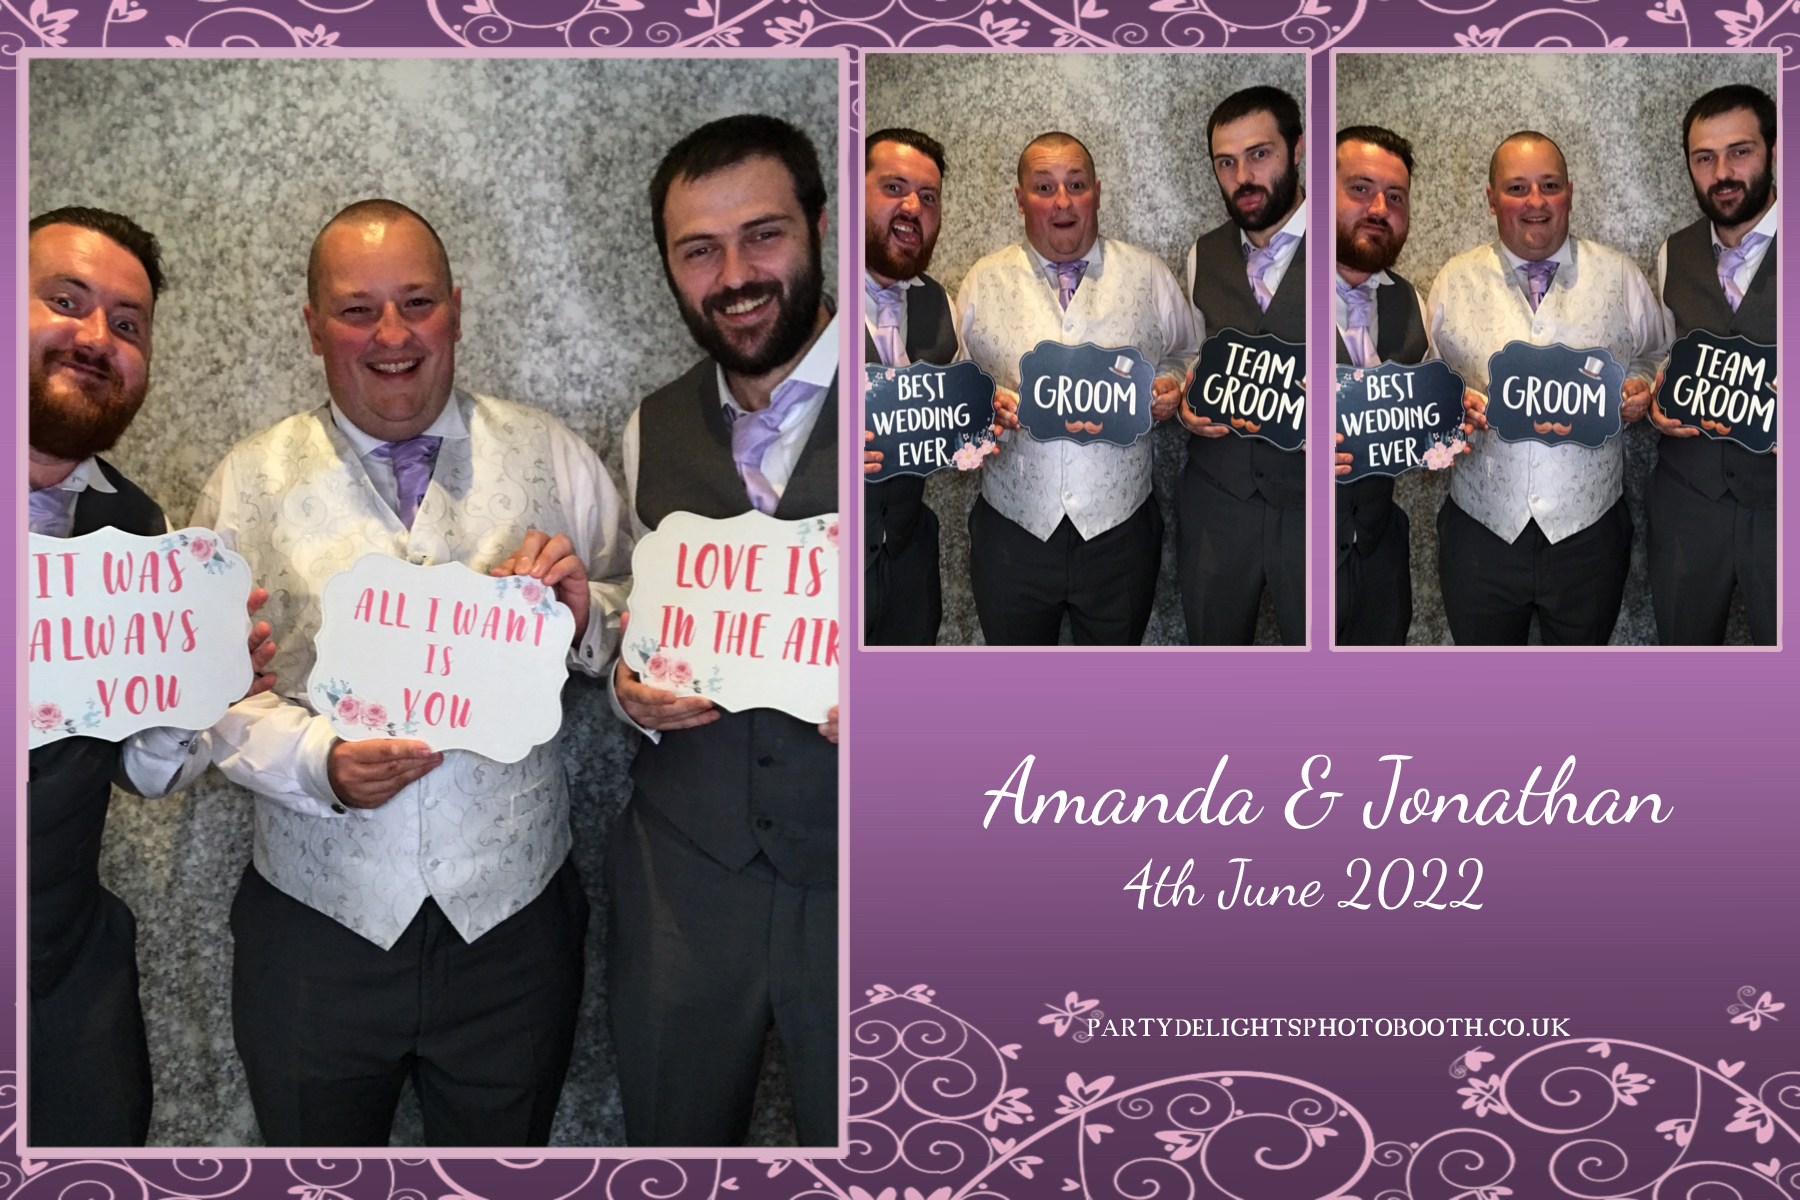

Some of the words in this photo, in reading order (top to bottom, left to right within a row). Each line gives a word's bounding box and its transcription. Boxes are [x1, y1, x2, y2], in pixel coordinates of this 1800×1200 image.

[897, 372, 946, 402] BEST
[1225, 342, 1296, 389] TEAM
[1366, 372, 1415, 402] BEST
[1695, 343, 1766, 391] TEAM
[1033, 375, 1137, 416] GROOM
[1203, 373, 1305, 431] GROOM
[1502, 375, 1606, 417] GROOM
[1673, 375, 1775, 433] GROOM
[872, 403, 971, 436] WEDDING
[1341, 402, 1440, 437] WEDDING
[898, 437, 950, 467] EVER
[1368, 437, 1420, 467] EVER
[32, 552, 80, 599] IT
[102, 549, 186, 595] WAS
[676, 542, 768, 593] LOVE
[783, 546, 827, 597] IS
[354, 587, 410, 629] ALL
[425, 597, 442, 633] I
[29, 609, 199, 662] ALWAYS
[713, 610, 771, 658] THE
[424, 643, 453, 676] IS
[96, 674, 182, 718] YOU
[403, 687, 472, 729] YOU
